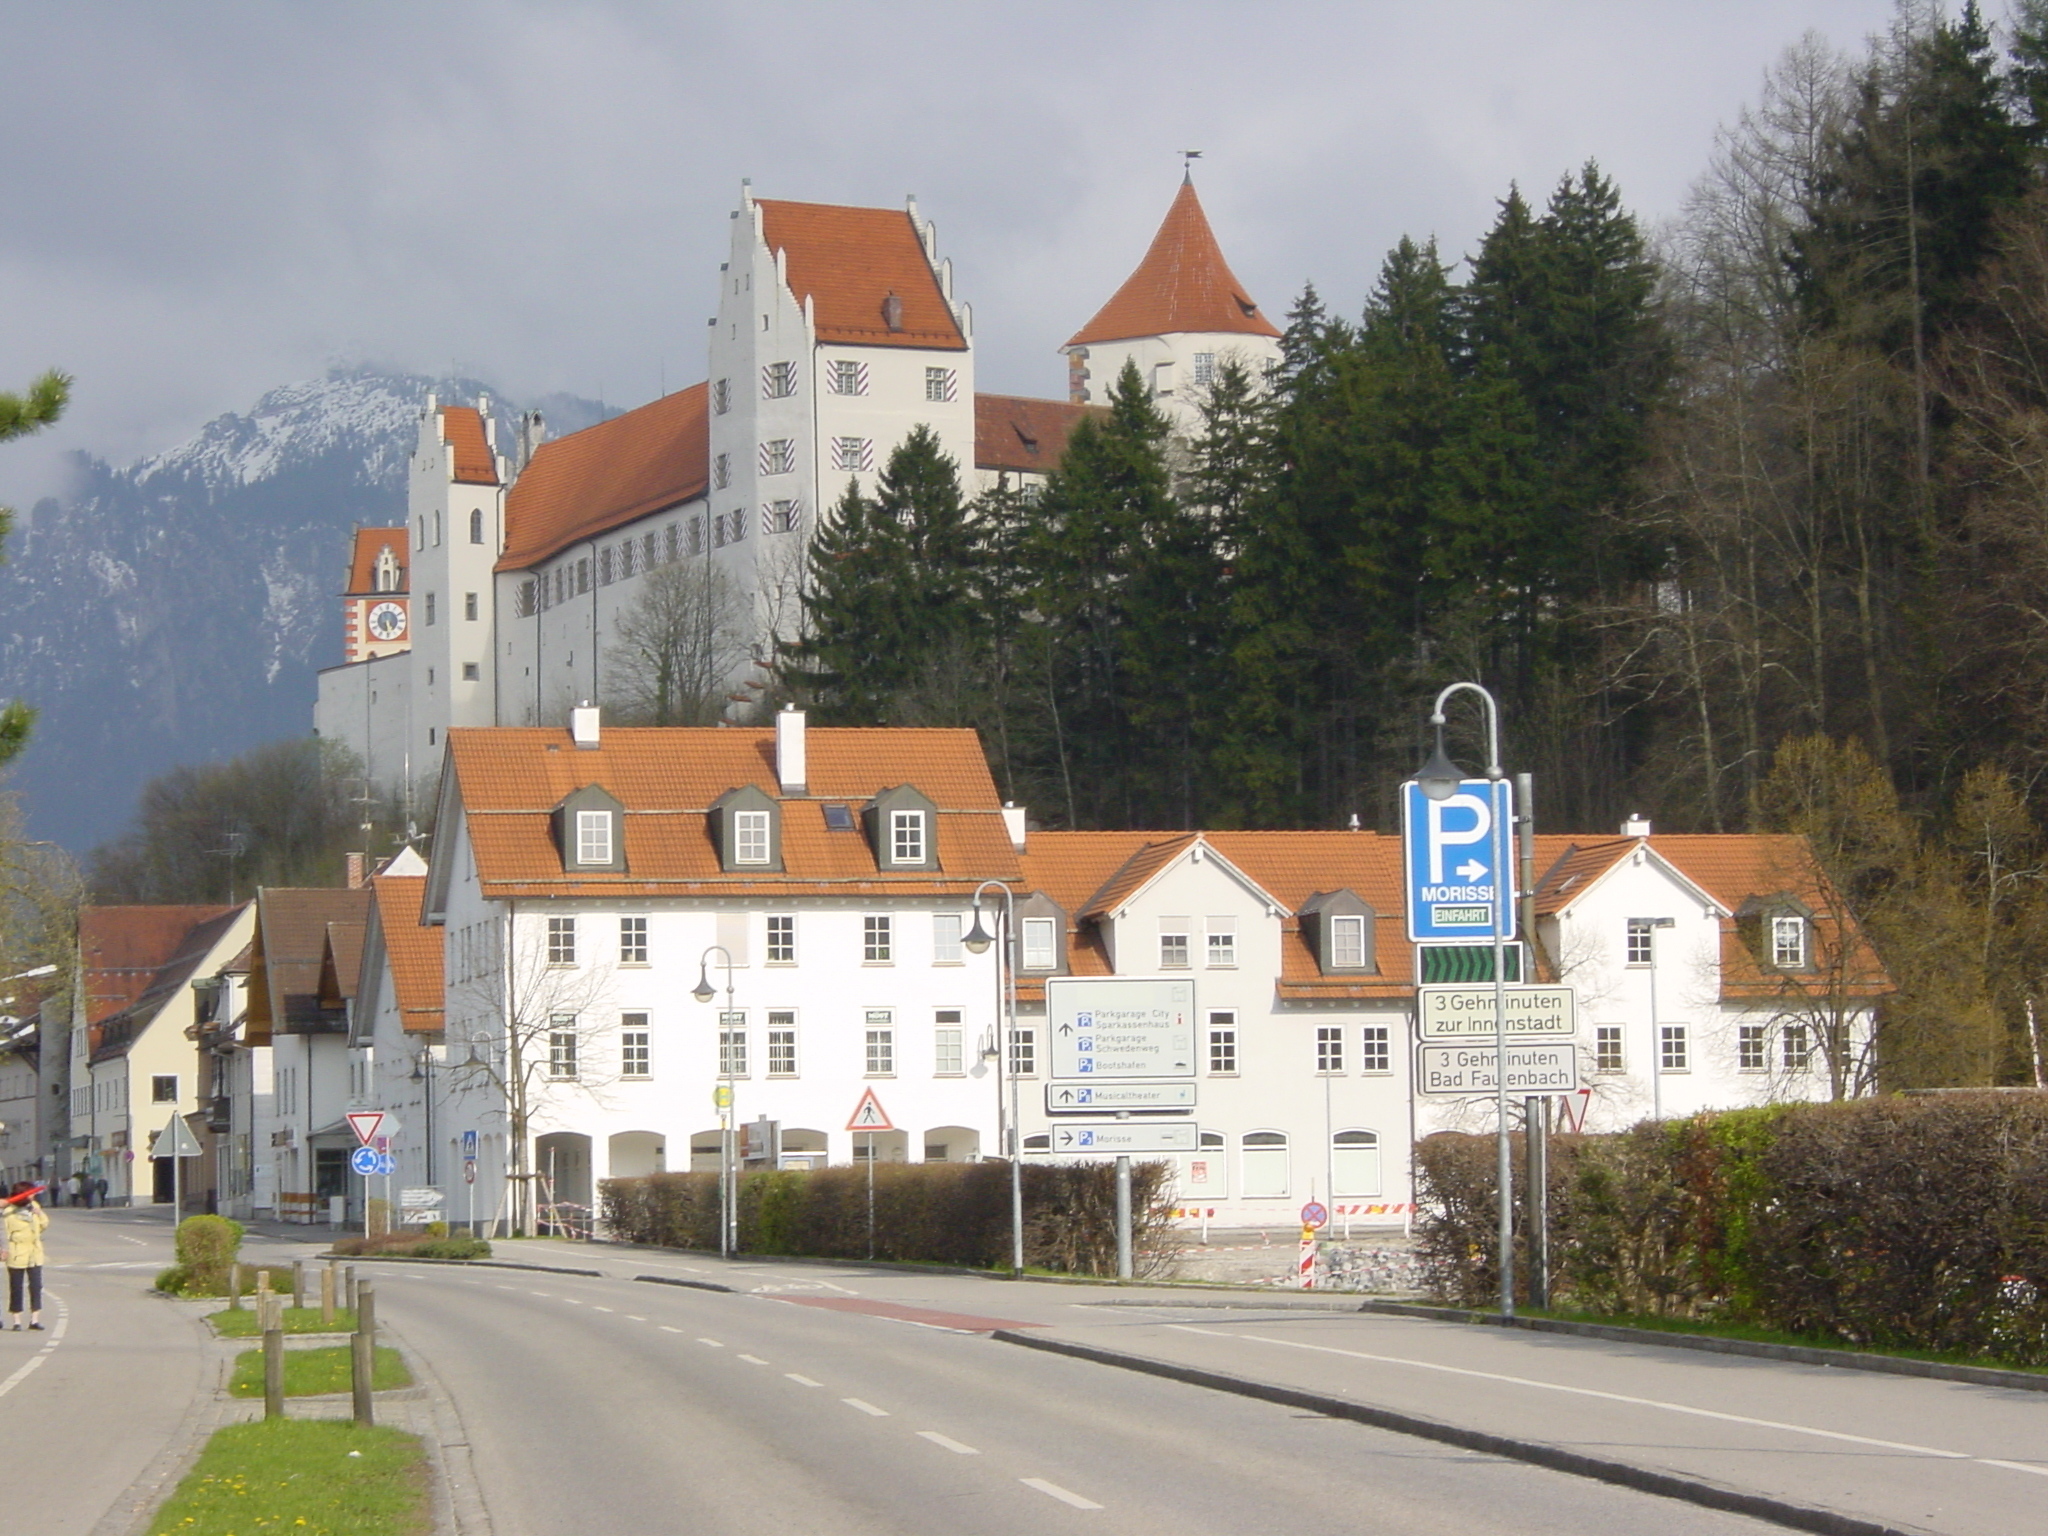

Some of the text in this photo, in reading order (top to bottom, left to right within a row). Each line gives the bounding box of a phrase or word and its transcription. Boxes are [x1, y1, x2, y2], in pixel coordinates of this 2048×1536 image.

[1428, 794, 1491, 884] P
[1435, 909, 1486, 923] EINFAHRT
[1435, 995, 1447, 1011] 3
[1095, 1009, 1147, 1020] Parkgarage
[1152, 1009, 1170, 1020] City
[1096, 1020, 1170, 1030] Sparkassenhaus
[1436, 1014, 1562, 1033] zur Innnstadt
[1095, 1034, 1147, 1044] Parkgarage
[1096, 1044, 1160, 1054] Schwedenweg
[1096, 1061, 1147, 1070] Bootshafen
[1440, 1052, 1450, 1068] 3
[1430, 1069, 1569, 1088] Bad Fauenbach
[1095, 1091, 1161, 1100] Musicaltheater
[1096, 1134, 1132, 1143] Morisse
